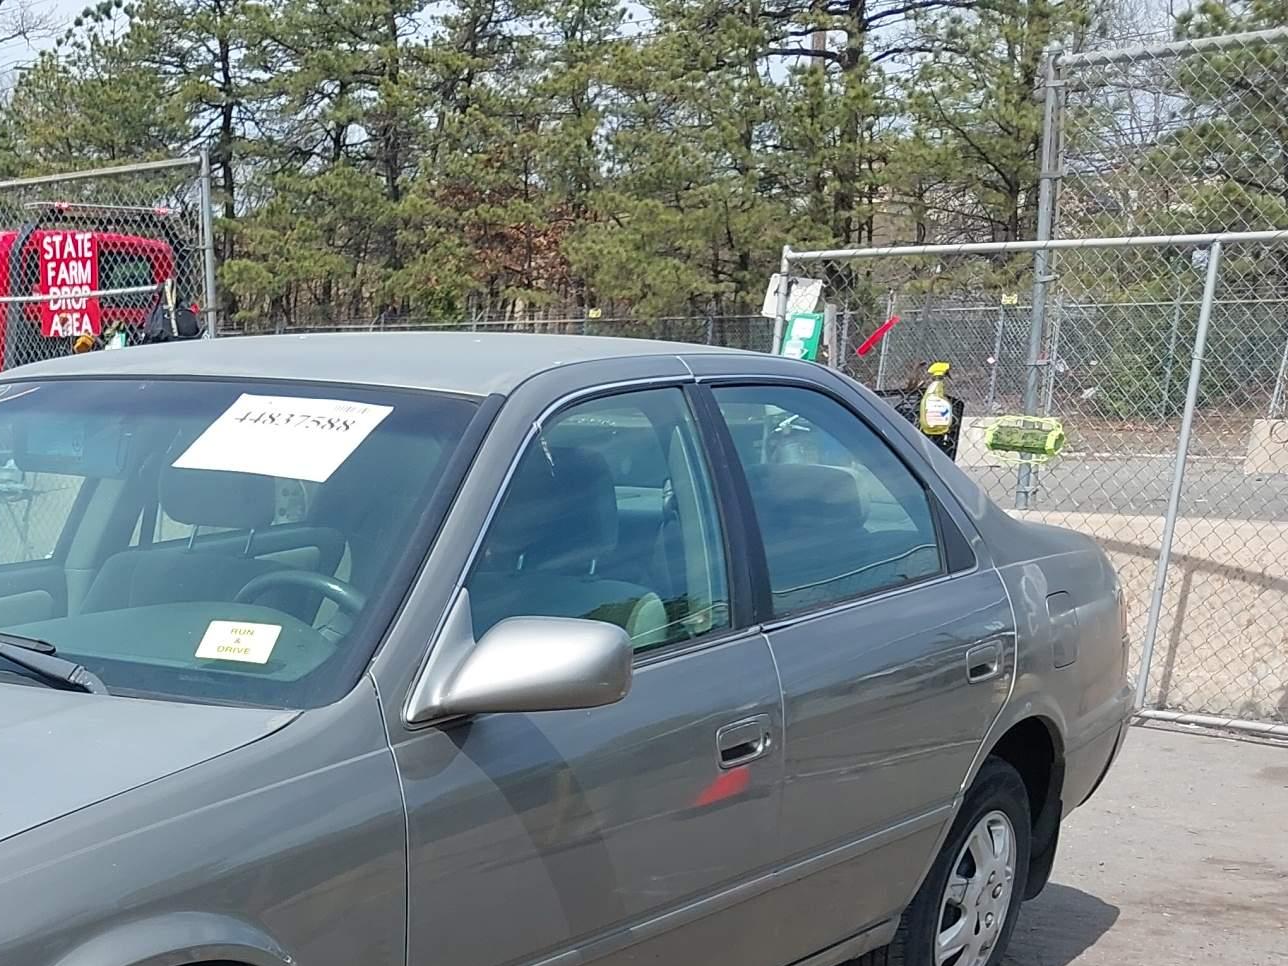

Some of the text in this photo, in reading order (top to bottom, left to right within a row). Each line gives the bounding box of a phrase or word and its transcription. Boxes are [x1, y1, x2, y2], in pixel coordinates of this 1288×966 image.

[42, 232, 93, 260] STATE
[46, 259, 92, 286] FARM
[49, 284, 91, 311] DROP
[234, 411, 356, 432] 44837588
[230, 628, 255, 636] RUN
[216, 645, 250, 655] DRIVE
